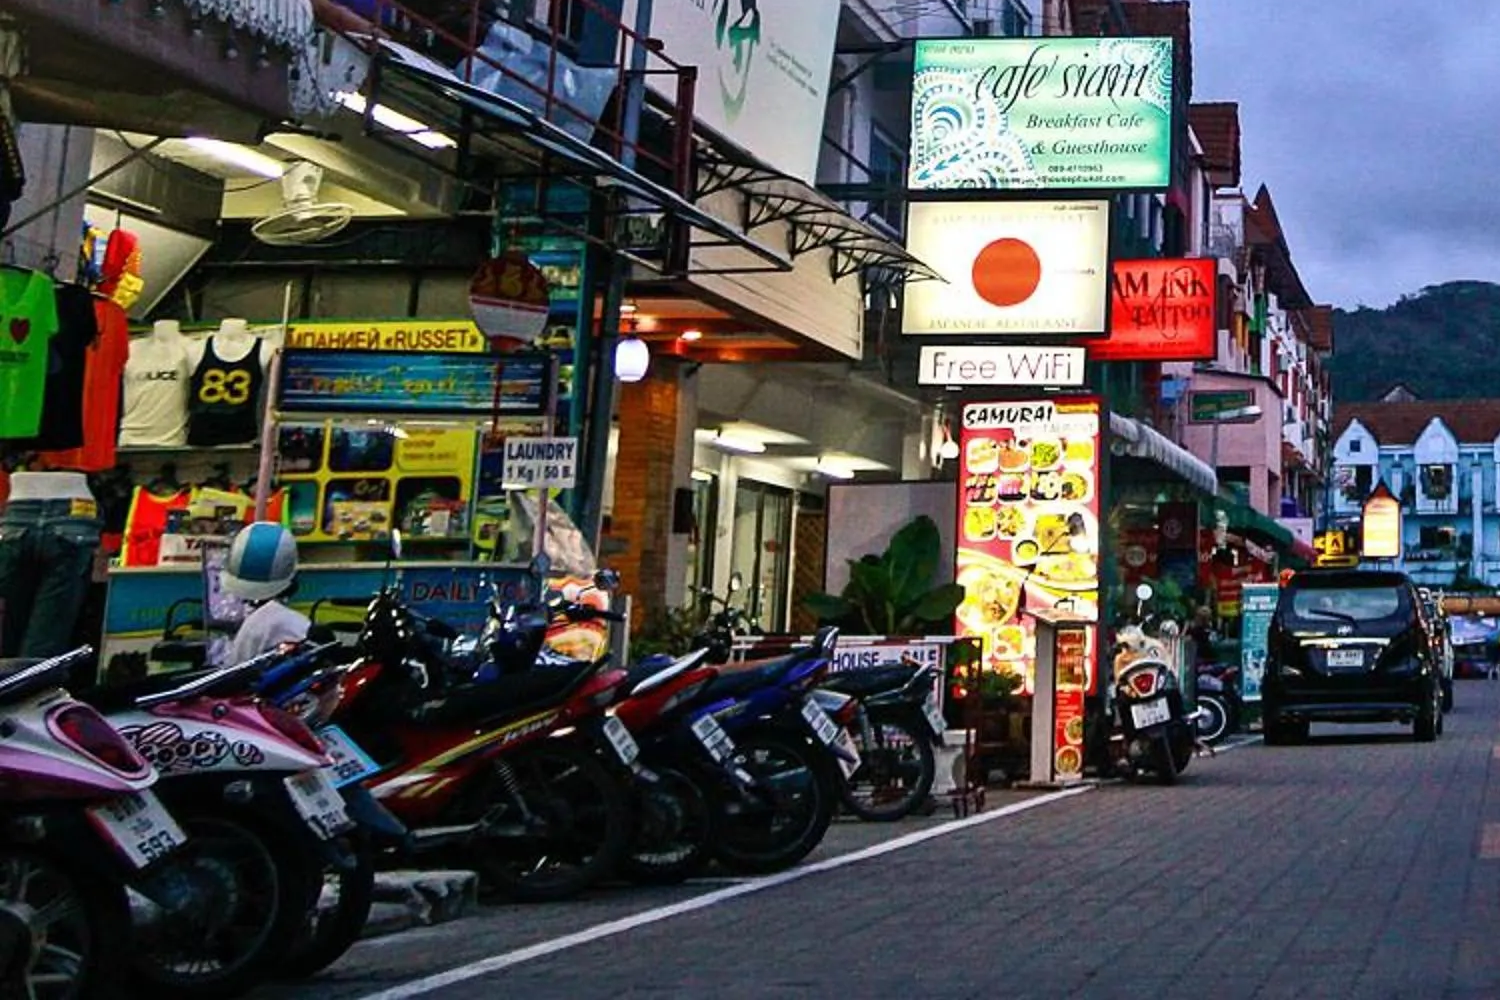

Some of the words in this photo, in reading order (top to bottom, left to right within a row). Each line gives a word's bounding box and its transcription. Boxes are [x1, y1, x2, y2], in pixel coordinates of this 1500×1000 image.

[1054, 52, 1150, 112] siam
[1026, 113, 1102, 133] Breakfast
[1106, 112, 1145, 129] Cafe
[1031, 142, 1047, 155] &
[1051, 139, 1148, 156] Guesthouse
[933, 352, 996, 380] Free
[1008, 353, 1072, 381] WiFi
[200, 369, 250, 404] 83
[965, 406, 1053, 426] SAMURAI
[507, 441, 575, 461] LAUNDRY
[516, 465, 534, 482] Kg
[544, 465, 559, 479] 50
[832, 650, 880, 671] HOUSE
